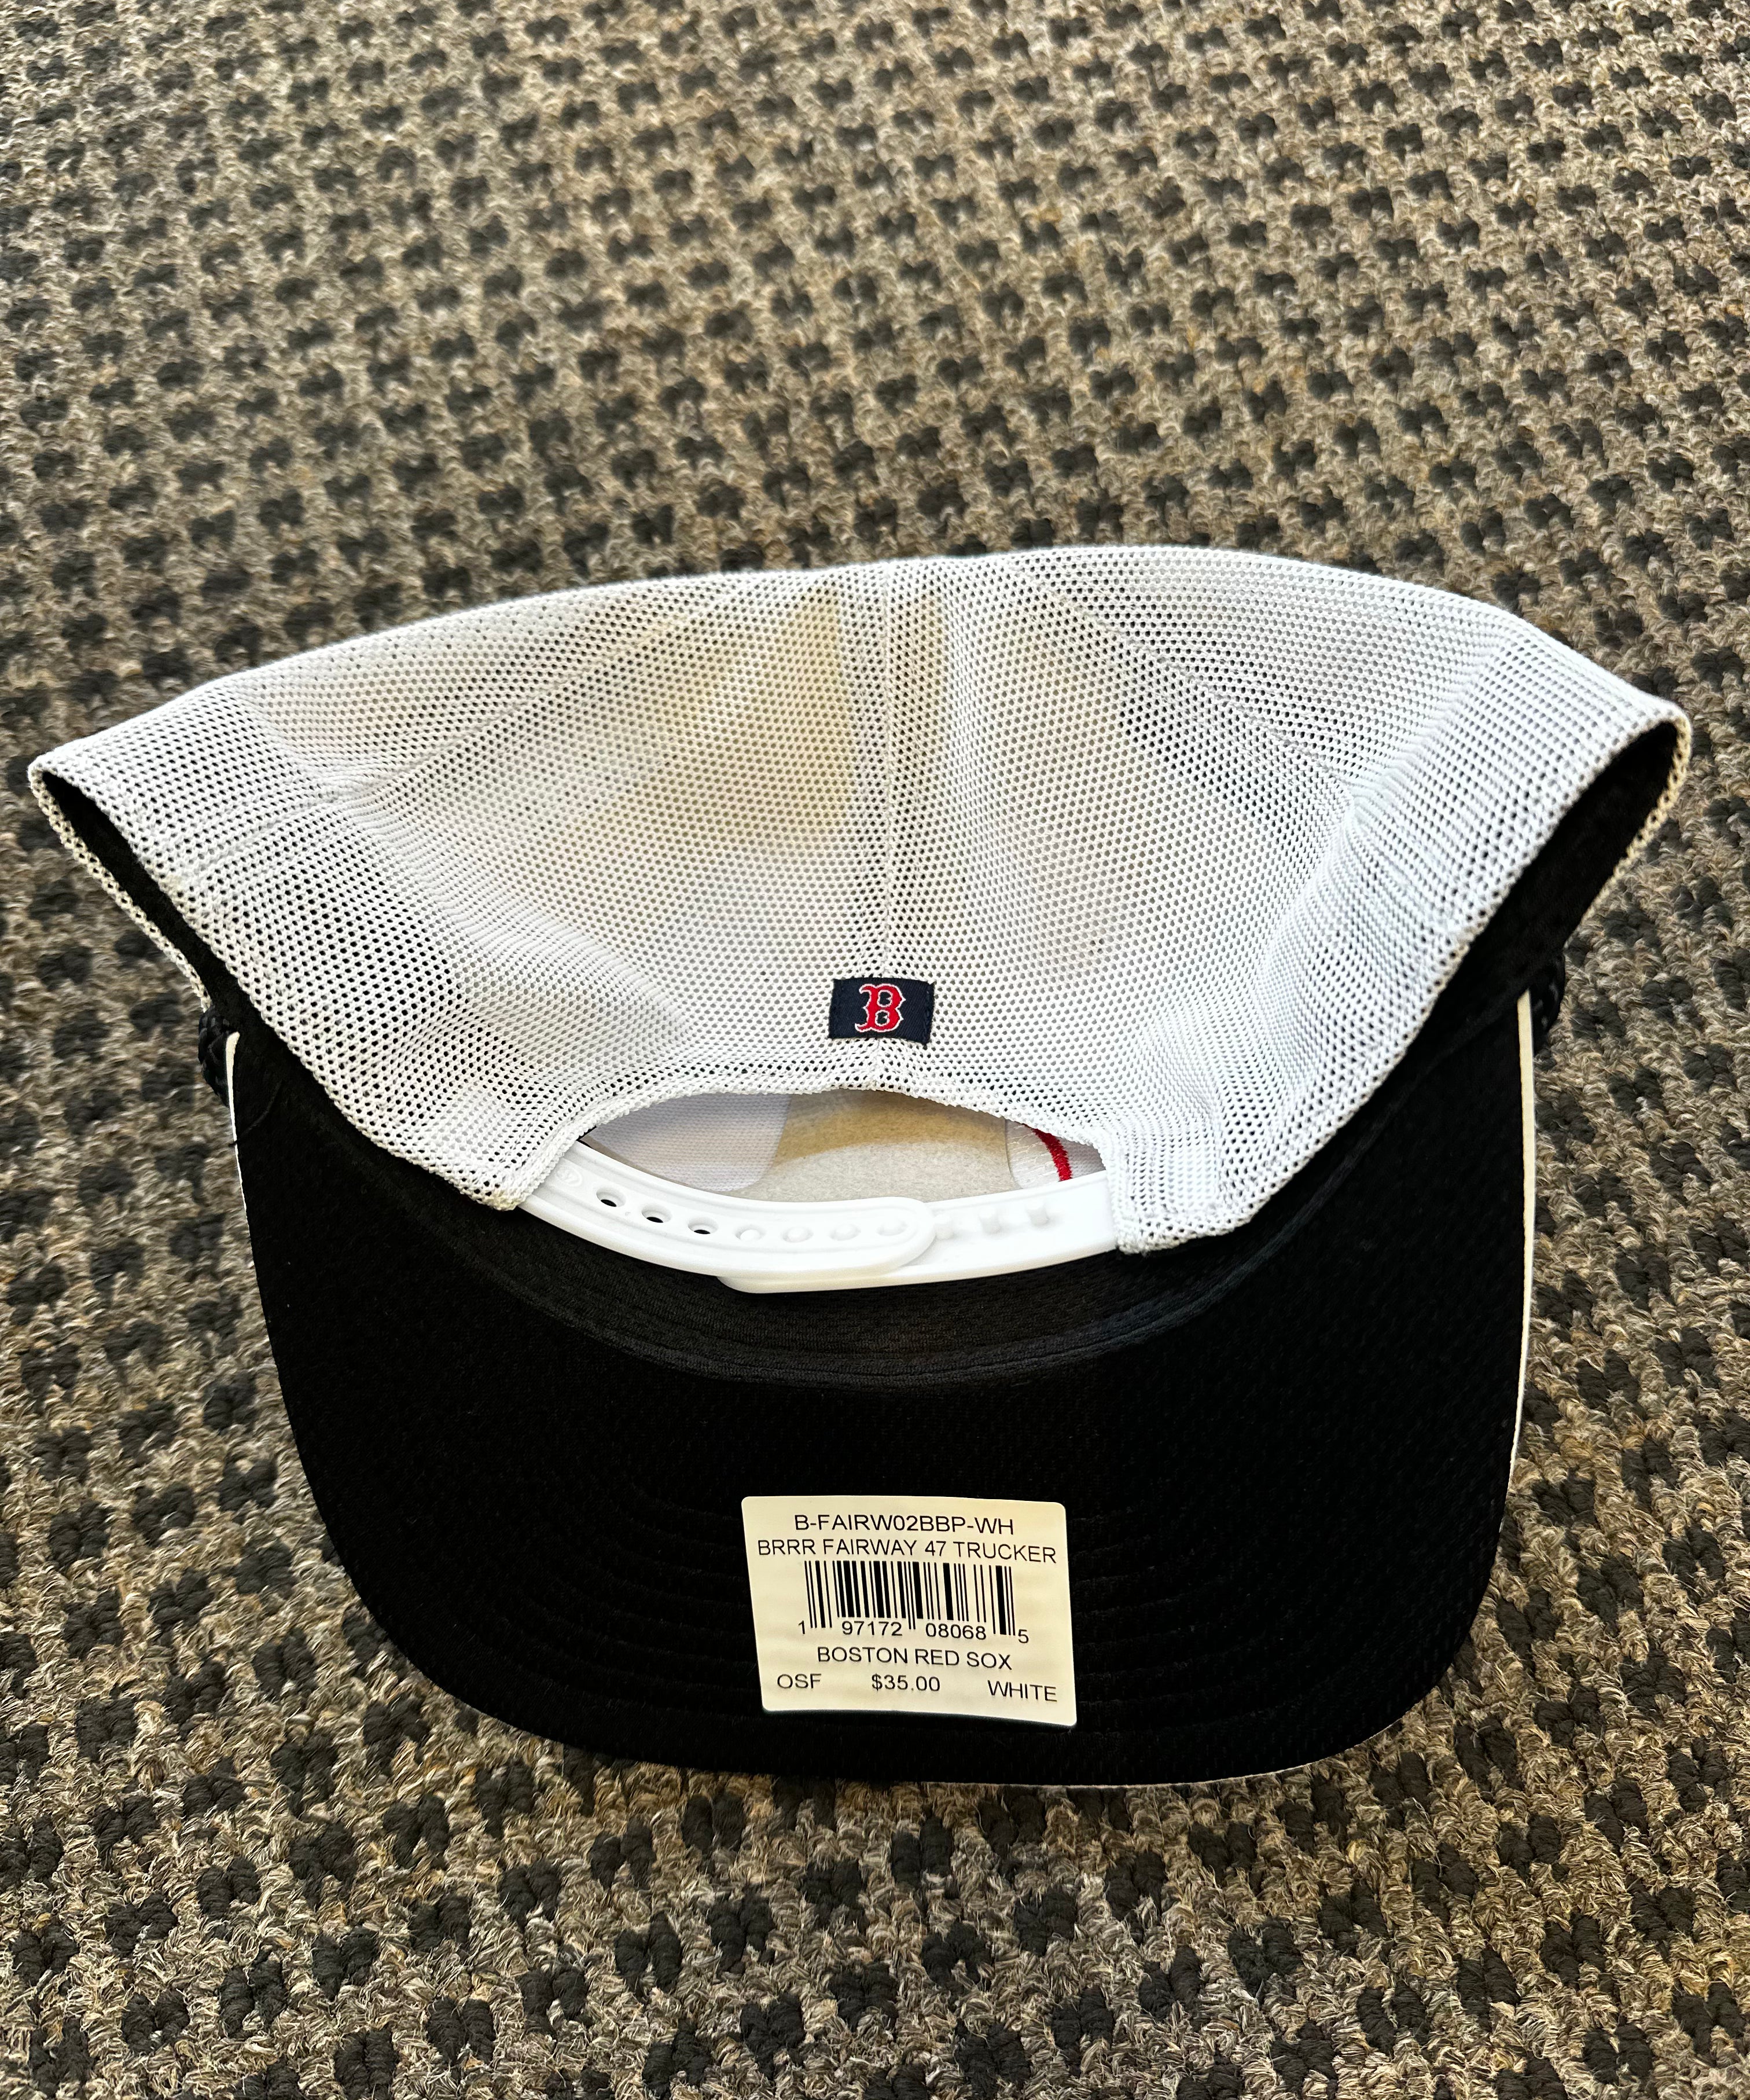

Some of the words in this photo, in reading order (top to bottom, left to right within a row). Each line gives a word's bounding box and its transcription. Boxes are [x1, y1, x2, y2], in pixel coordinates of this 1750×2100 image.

[854, 983, 906, 1033] B
[794, 1514, 1014, 1535] B-FAIRW02BBP-WH
[758, 1539, 815, 1556] BRRR
[823, 1539, 917, 1556] FAIRWAY
[924, 1541, 947, 1557] 47
[953, 1542, 1057, 1563] TRUCKER
[797, 1620, 807, 1635] 1
[841, 1621, 902, 1636] 97172
[925, 1623, 987, 1640] 08068
[1018, 1629, 1029, 1643] 5
[817, 1647, 908, 1664] BOSTON
[916, 1649, 959, 1666] RED
[966, 1653, 1013, 1669] SOX
[777, 1674, 822, 1690] OSF
[872, 1674, 940, 1692] $35.00
[987, 1680, 1058, 1702] WHITE
